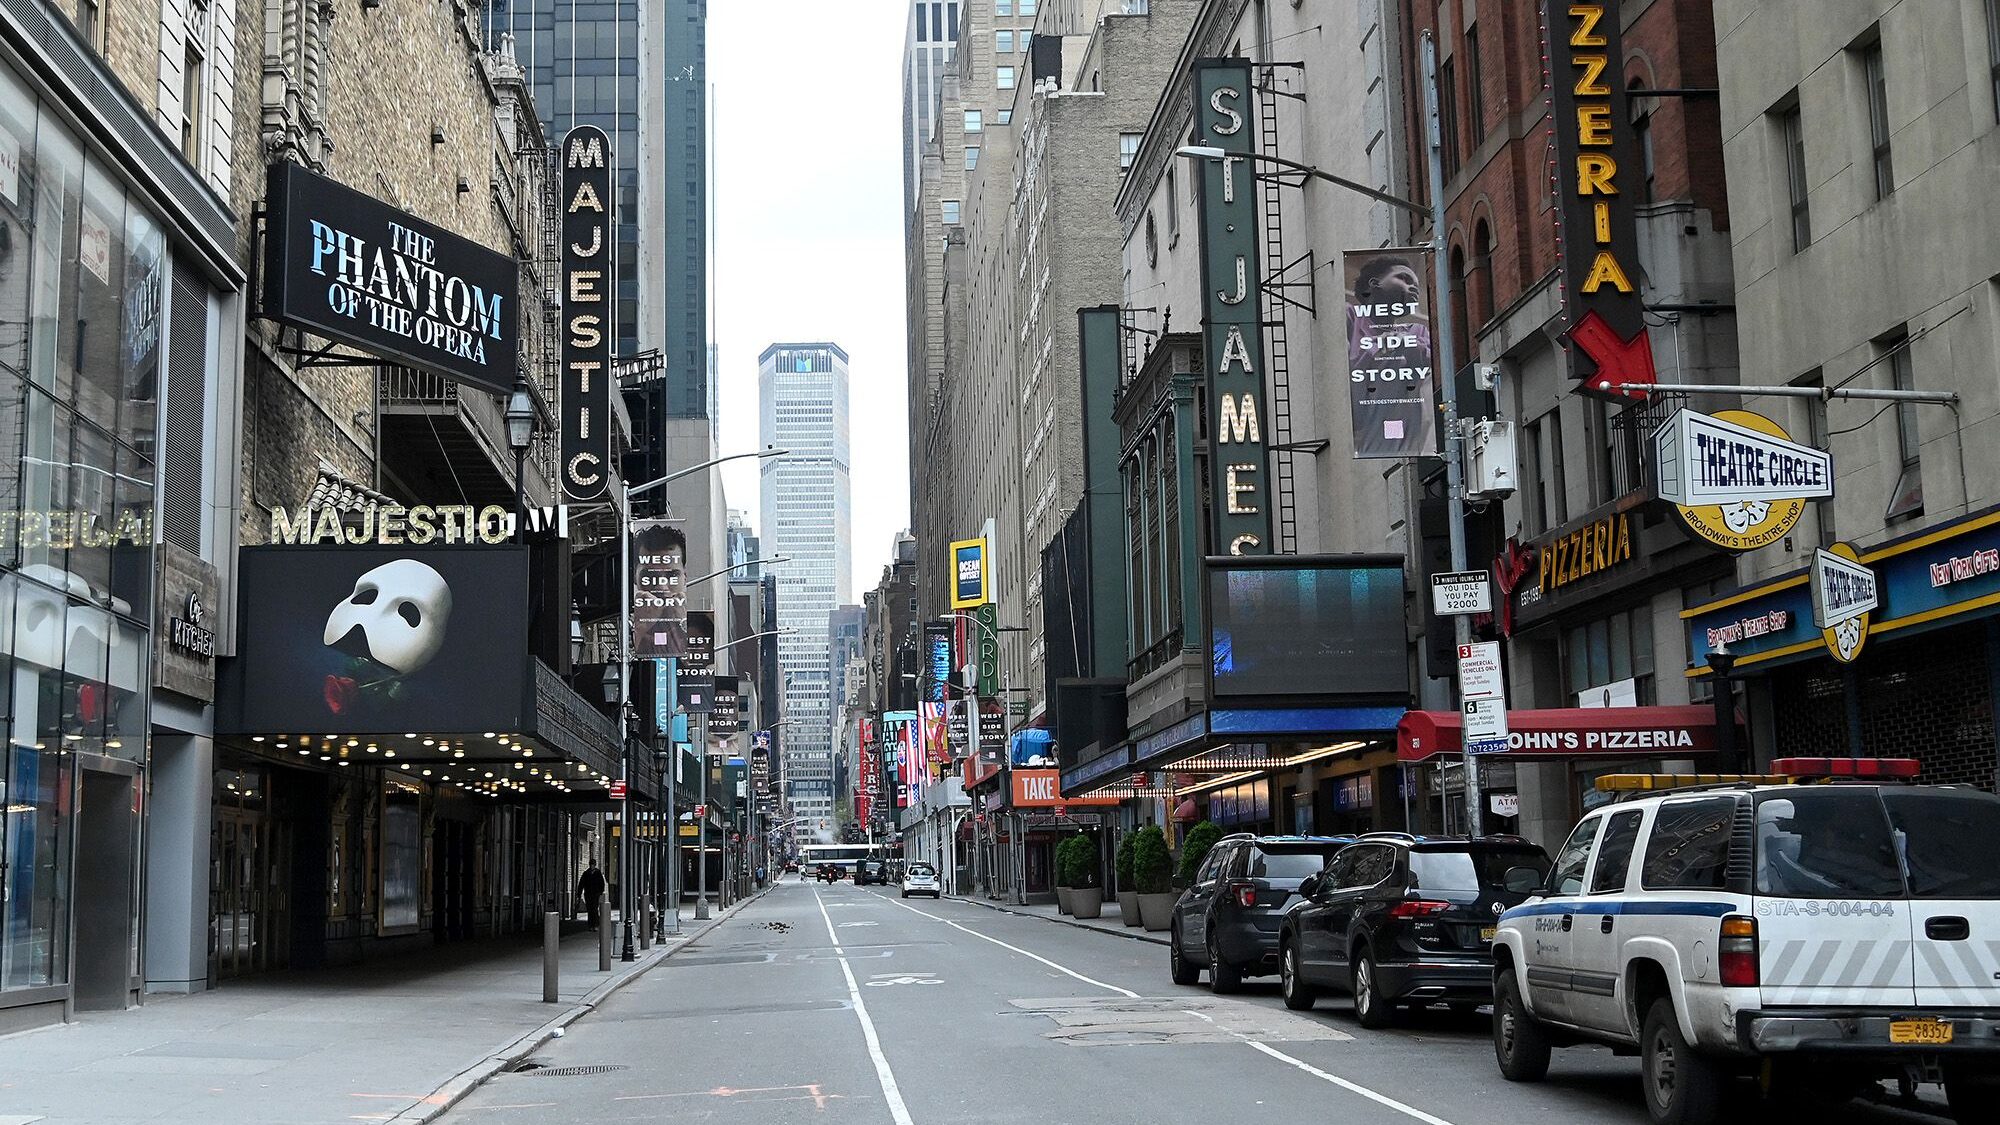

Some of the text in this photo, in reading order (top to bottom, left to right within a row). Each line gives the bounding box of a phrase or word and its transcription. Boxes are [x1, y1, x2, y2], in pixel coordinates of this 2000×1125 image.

[388, 221, 436, 266] THE
[309, 218, 503, 341] PHANTOM
[567, 137, 604, 486] MAJESTIC
[1354, 302, 1419, 318] WEST
[328, 283, 487, 366] OF THE OPERA
[1360, 335, 1417, 350] SIDE
[1351, 366, 1429, 382] STORY
[1697, 433, 1822, 487] THEATRE CIRCLE
[271, 504, 509, 545] MAJESTIC
[1684, 501, 1800, 547] BROADWAY'S THEATRE SHOP
[639, 555, 681, 564] WEST
[1539, 512, 1631, 594] PIZZERIA
[959, 560, 980, 571] OCEAN
[1930, 548, 1999, 588] NEW YORK GIFTS
[641, 577, 679, 586] SIDE
[1461, 583, 1480, 591] IDLE
[1824, 566, 1853, 611] THEATRE
[635, 598, 685, 607] STORY
[1445, 592, 1461, 600] YOU
[1447, 599, 1478, 609] $2000
[1707, 610, 1787, 648] BROADWAY'S THEATRE SHOP
[174, 617, 216, 658] KITCHEN
[1462, 646, 1469, 657] 3
[1462, 660, 1494, 668] COMMERCIAL
[1463, 666, 1485, 674] VEHICLES
[1467, 702, 1474, 713] 6
[1508, 730, 1694, 750] OHN'S PIZZERIA
[1022, 777, 1054, 800] TAKE
[1497, 798, 1518, 806] ATM
[1757, 900, 1895, 917] STA-S-004-04
